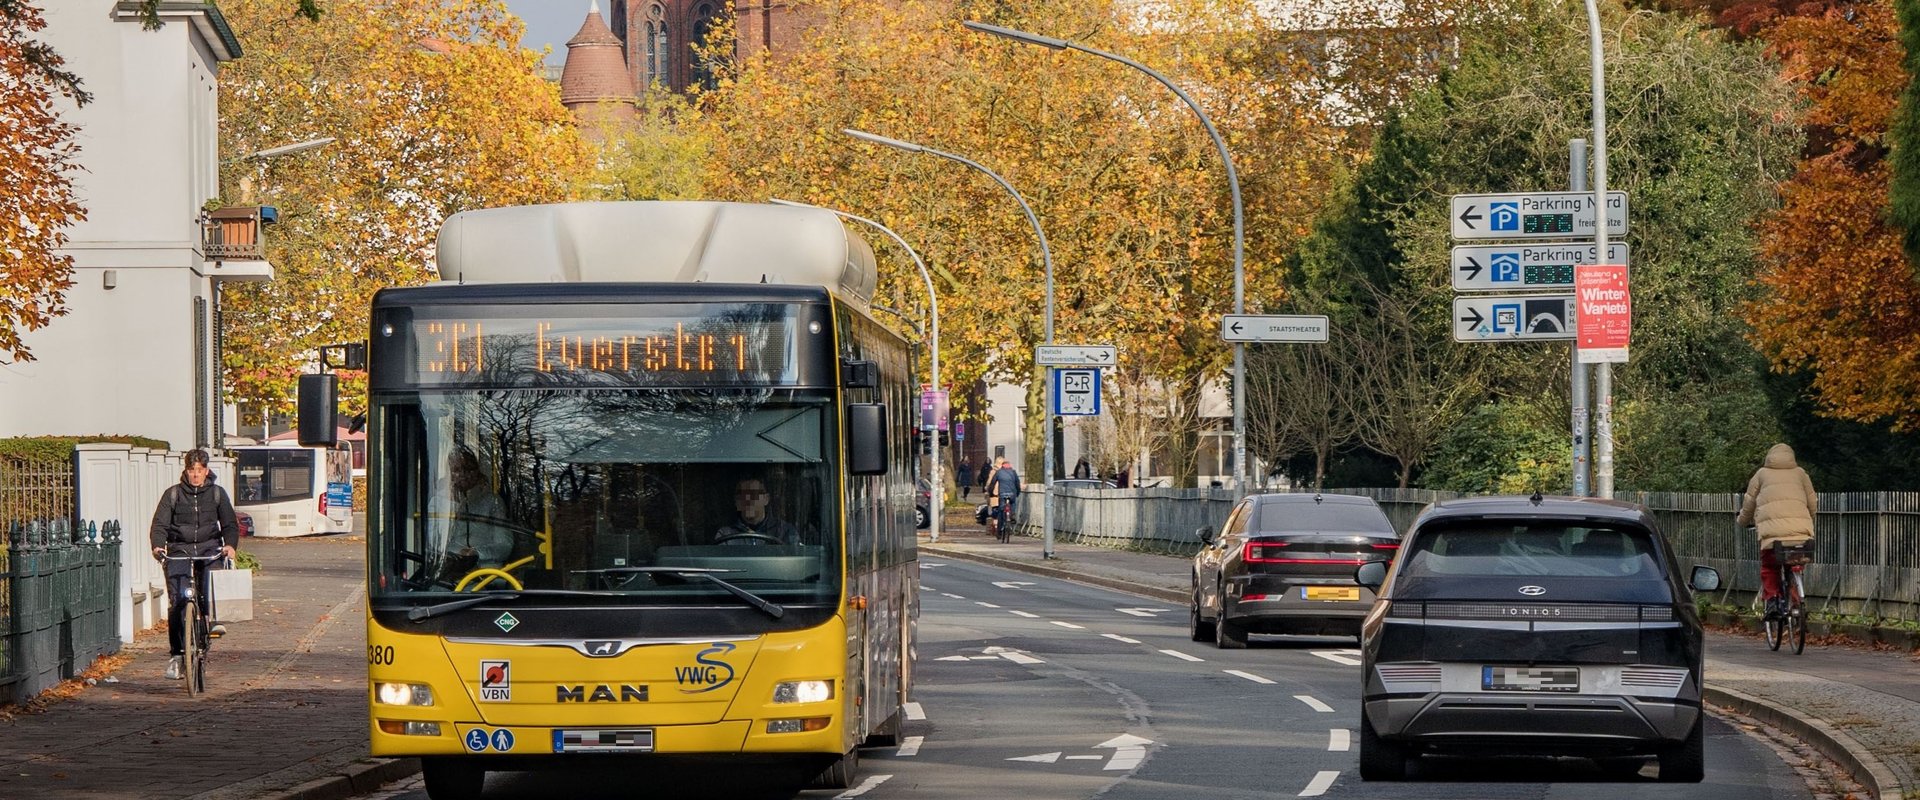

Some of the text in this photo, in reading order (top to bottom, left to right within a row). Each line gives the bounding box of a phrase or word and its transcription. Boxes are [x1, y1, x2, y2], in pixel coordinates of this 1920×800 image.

[1522, 196, 1621, 212] Parkring Nrd
[1525, 214, 1571, 233] 976
[1523, 246, 1615, 263] Parkring Sd
[1525, 265, 1573, 284] 833
[1581, 287, 1626, 301] Winter
[1582, 301, 1628, 315] Varieté
[1269, 325, 1321, 333] STAATSTHEATER
[1064, 376, 1090, 390] P+R
[1068, 394, 1085, 404] City
[499, 618, 515, 626] CNG
[369, 644, 395, 666] 380
[674, 666, 717, 685] VWG
[481, 688, 510, 701] VBN
[556, 684, 649, 703] MAN
